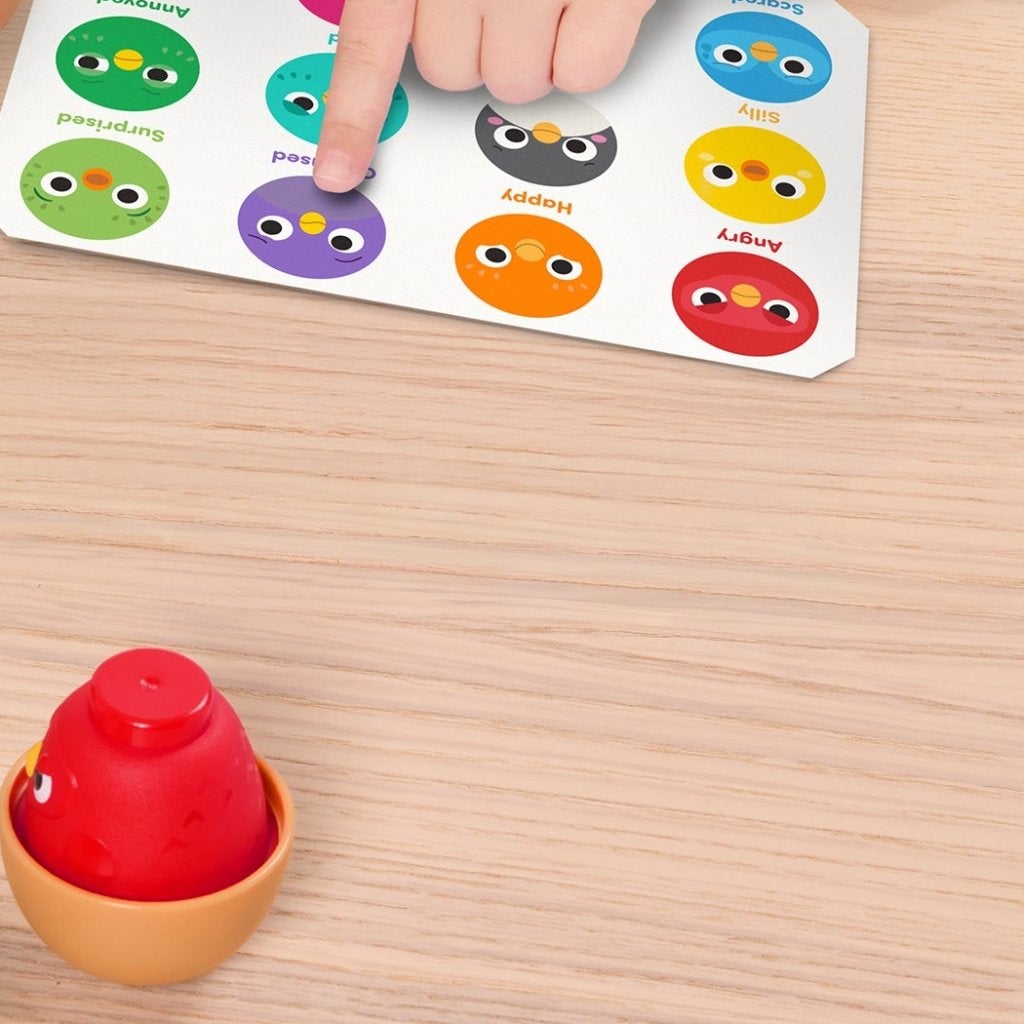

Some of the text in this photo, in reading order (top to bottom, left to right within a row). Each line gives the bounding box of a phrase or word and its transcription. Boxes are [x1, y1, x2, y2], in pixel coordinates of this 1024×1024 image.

[737, 102, 781, 125] Silly
[56, 112, 166, 144] Surprised
[500, 187, 574, 216] Happy
[716, 227, 784, 254] Angry
